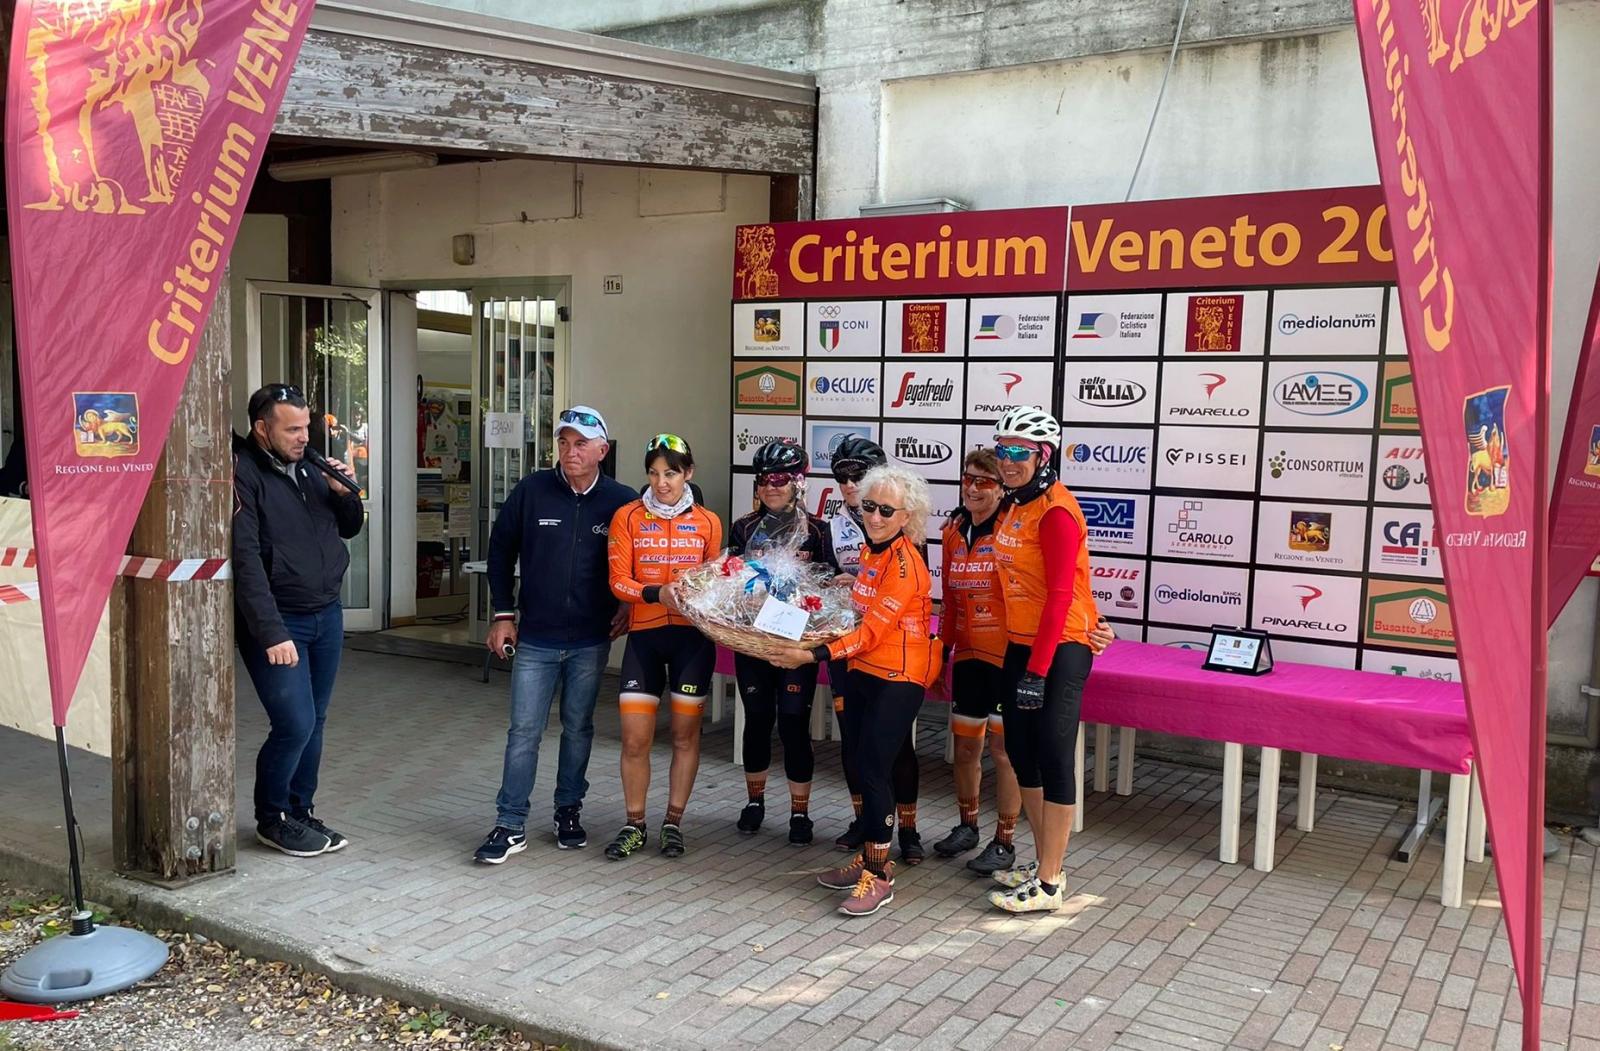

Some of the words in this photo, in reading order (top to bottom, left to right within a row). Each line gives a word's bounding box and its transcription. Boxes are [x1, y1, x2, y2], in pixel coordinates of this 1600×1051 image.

[148, 124, 257, 365] Criterium
[226, 0, 298, 114] VENE
[789, 225, 1047, 284] Criterium
[1071, 214, 1301, 273] Veneto
[1318, 204, 1394, 264] 20
[909, 304, 940, 312] Criterium
[1196, 297, 1236, 306] Criterium
[1018, 314, 1051, 322] Federazione
[1120, 312, 1155, 321] Federazione
[1282, 315, 1376, 330] mediolanum
[842, 320, 869, 331] CONI
[1120, 321, 1148, 330] Ciclistica
[1225, 306, 1235, 351] VENETO
[1119, 330, 1142, 339] Italiana
[831, 377, 875, 394] ECLISSE
[1080, 376, 1106, 385] selle
[891, 371, 954, 408] Segafredo
[1079, 384, 1135, 400] ITALIA
[1282, 382, 1352, 402] LAMES
[1169, 407, 1249, 417] PINARELLO
[895, 436, 918, 444] selle
[895, 443, 942, 459] ITALIA
[1093, 445, 1146, 464] ECLISSE
[1185, 452, 1246, 466] PISSEI
[1286, 458, 1364, 473] CONSORTIUM
[55, 464, 103, 474] REGIONE
[1088, 529, 1134, 540] EMME
[1178, 532, 1233, 545] CAROLLO
[1274, 552, 1303, 562] REGIONE
[1315, 556, 1344, 564] VENETO
[1091, 589, 1112, 601] eep
[1158, 588, 1241, 605] mediolanum
[1261, 617, 1347, 632] PINARELLO
[1375, 620, 1417, 634] Busatto
[1420, 625, 1454, 639] Legna
